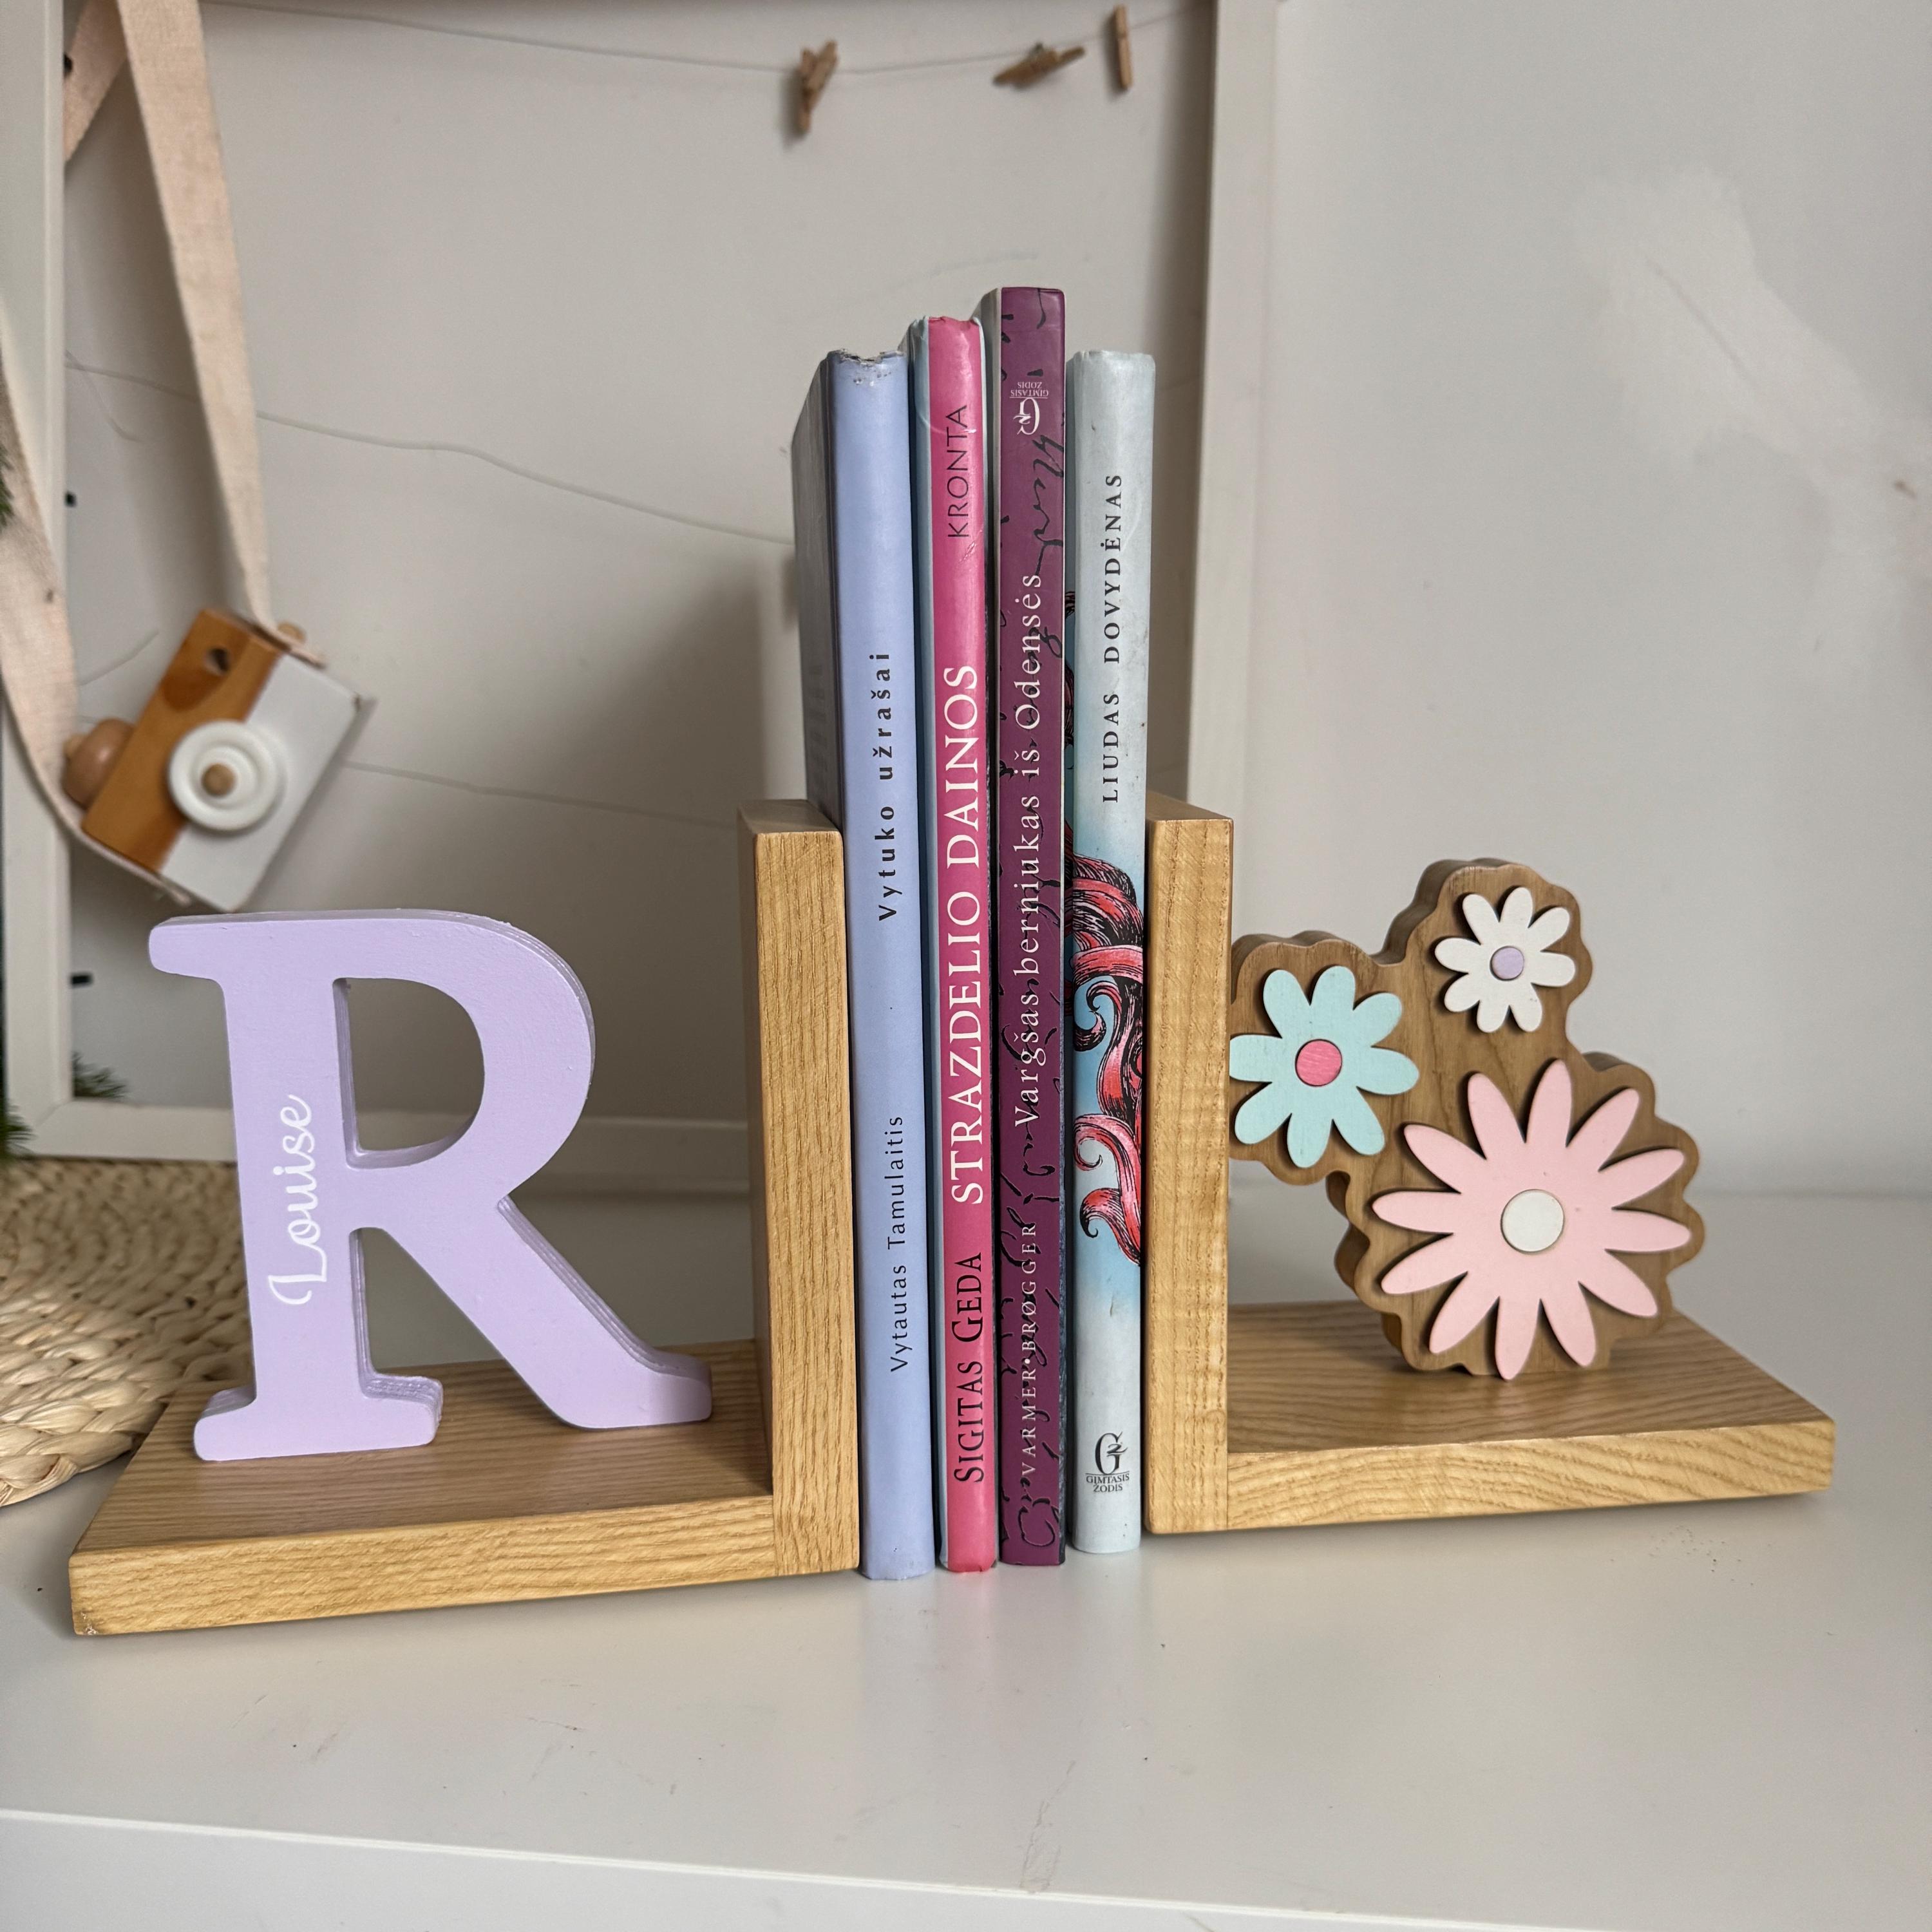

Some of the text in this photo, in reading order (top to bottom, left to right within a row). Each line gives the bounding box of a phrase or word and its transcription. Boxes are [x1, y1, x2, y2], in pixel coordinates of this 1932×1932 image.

[946, 405, 969, 538] KRONTA
[1101, 475, 1122, 803] LIUDAS DOVYDĖNAS
[869, 654, 903, 921] Vytuko užrašai
[1013, 574, 1046, 1127] Vargšas berniukas iš Odensės
[943, 665, 983, 1204] STRAZDELIO DAINOS
[148, 909, 714, 1463] R
[268, 1095, 327, 1305] Louise
[884, 1117, 913, 1372] Vytautas Tamulaitis
[951, 1253, 985, 1482] SIGITAS GEDA
[1086, 1473, 1130, 1484] GIMTASIS
